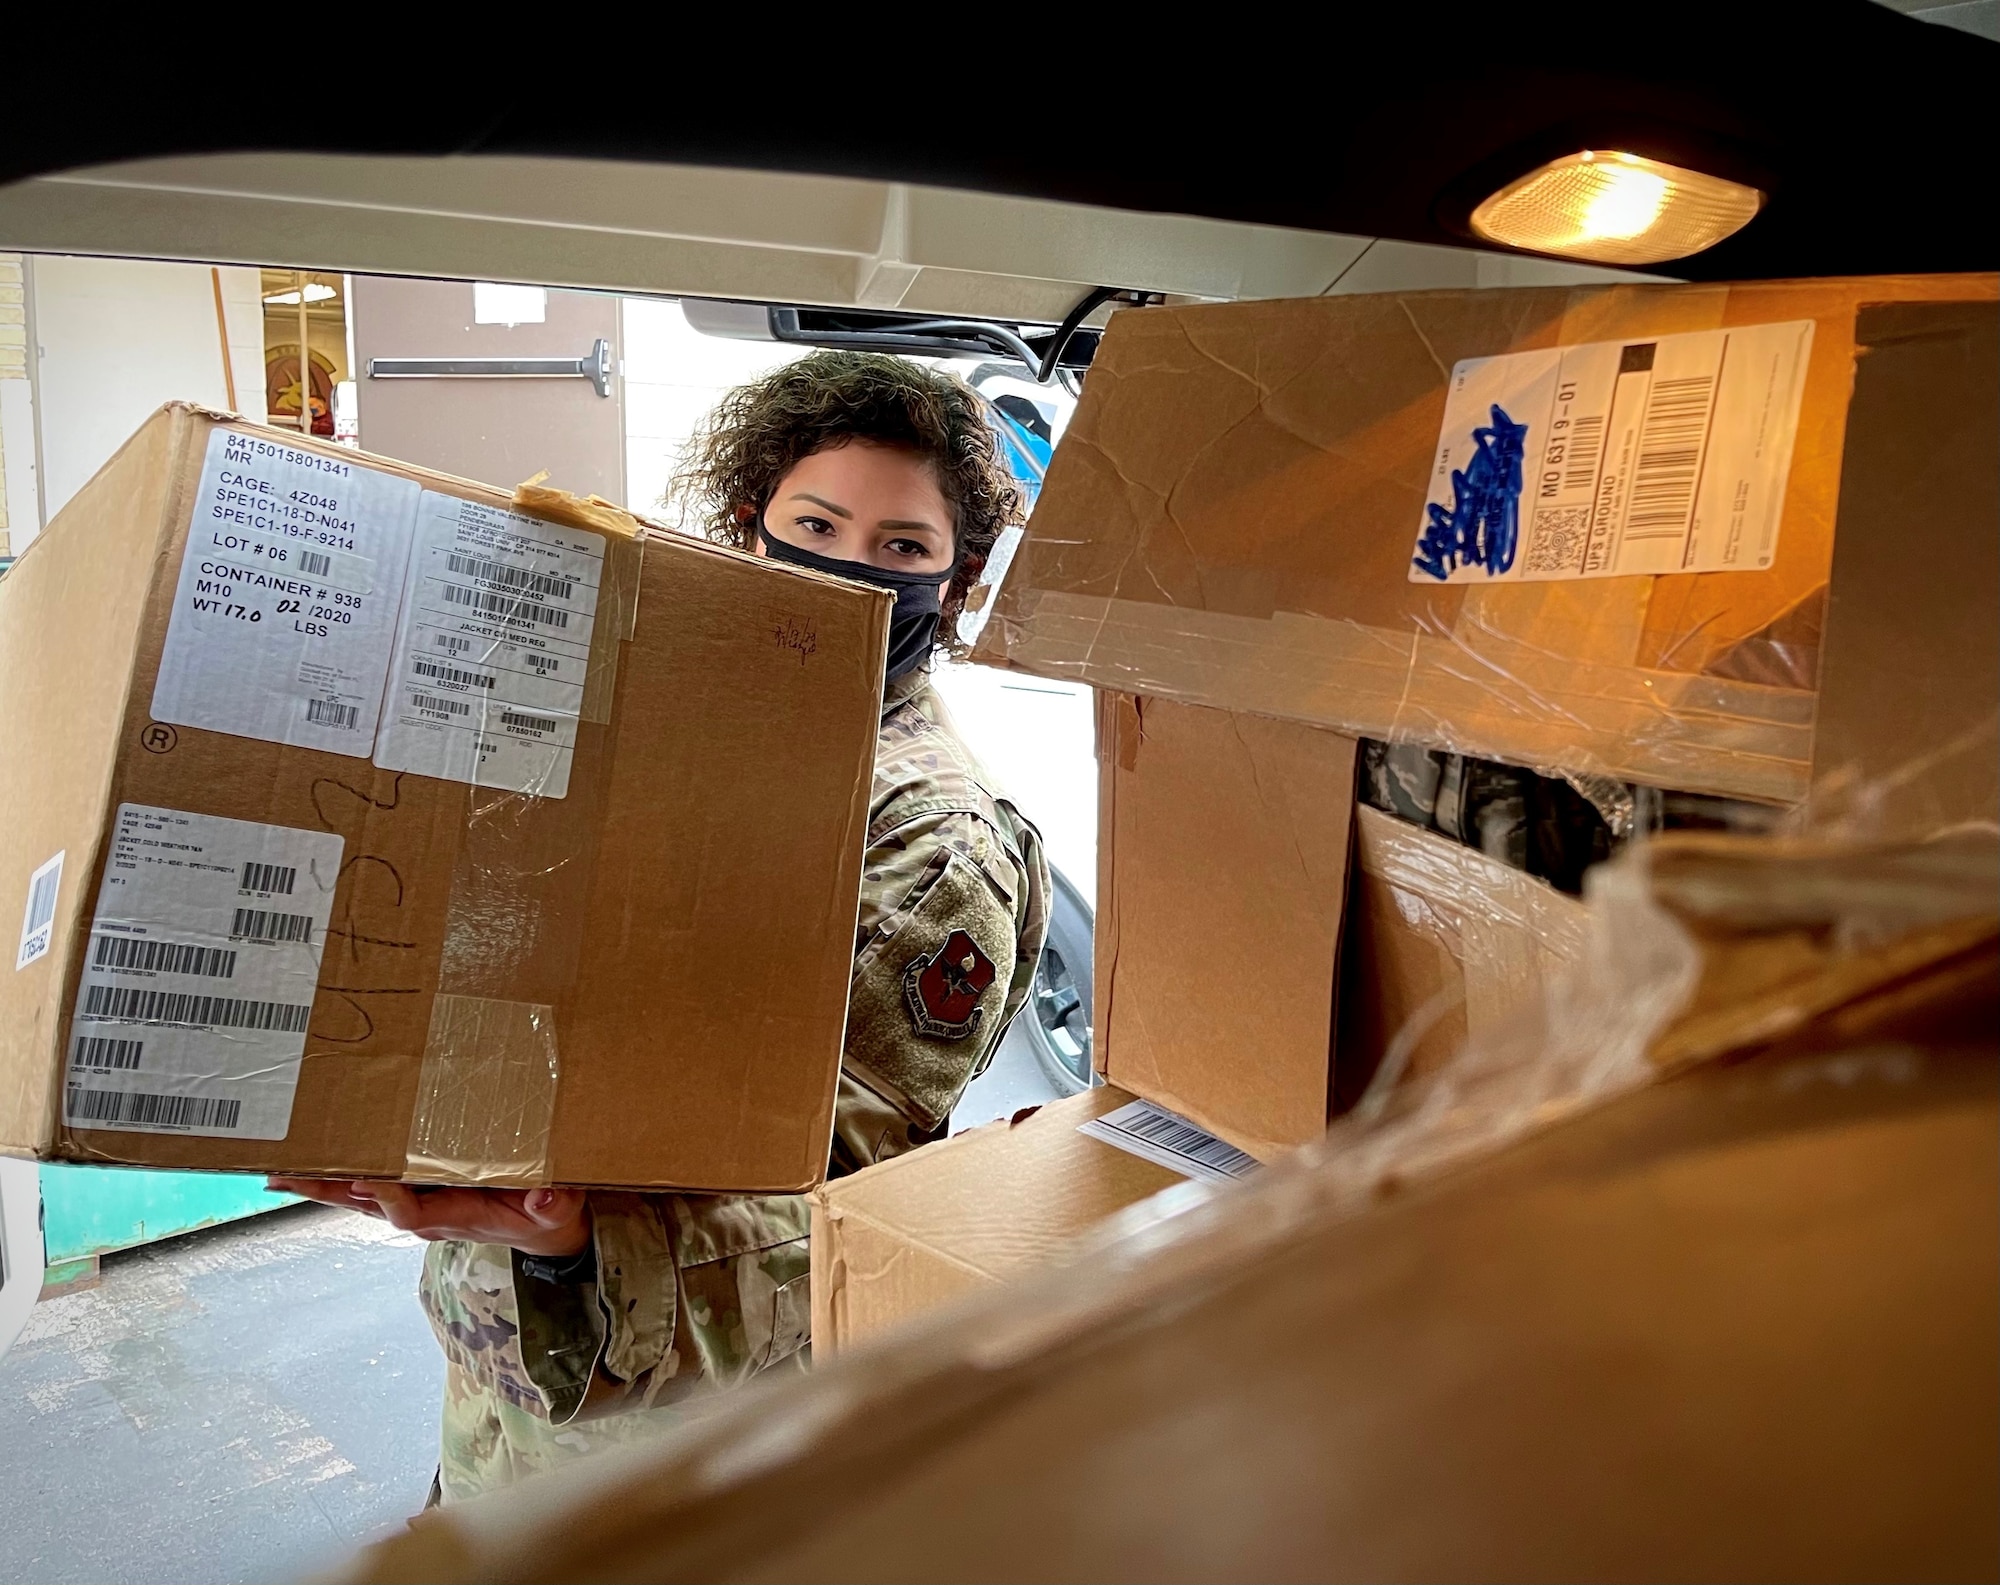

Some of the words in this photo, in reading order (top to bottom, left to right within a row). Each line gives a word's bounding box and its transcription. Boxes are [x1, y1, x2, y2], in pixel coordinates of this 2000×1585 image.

[224, 448, 252, 465] MR
[227, 434, 350, 478] 8415015801341
[220, 471, 275, 495] CAGE:
[289, 490, 338, 511] 4Z048
[1541, 472, 1559, 498] MO
[216, 488, 356, 534] SPE1C1-18-D-N041
[1594, 475, 1616, 537] GROUND
[212, 506, 354, 550] SPE1C1-19-F-9214
[213, 532, 249, 551] LOT
[253, 543, 264, 555] #
[269, 547, 288, 561] 06
[1587, 544, 1604, 571] UPS
[196, 580, 232, 597] M10
[200, 561, 312, 598] CONTAINER
[316, 589, 327, 600] #
[334, 593, 362, 609] 938
[193, 597, 222, 614] WT
[294, 620, 328, 637] LBS
[460, 622, 492, 636] JACKET
[509, 633, 527, 644] MED
[448, 649, 457, 657] 12
[536, 667, 547, 676] EA
[437, 679, 469, 692] 6320027
[419, 708, 450, 721] FY1908
